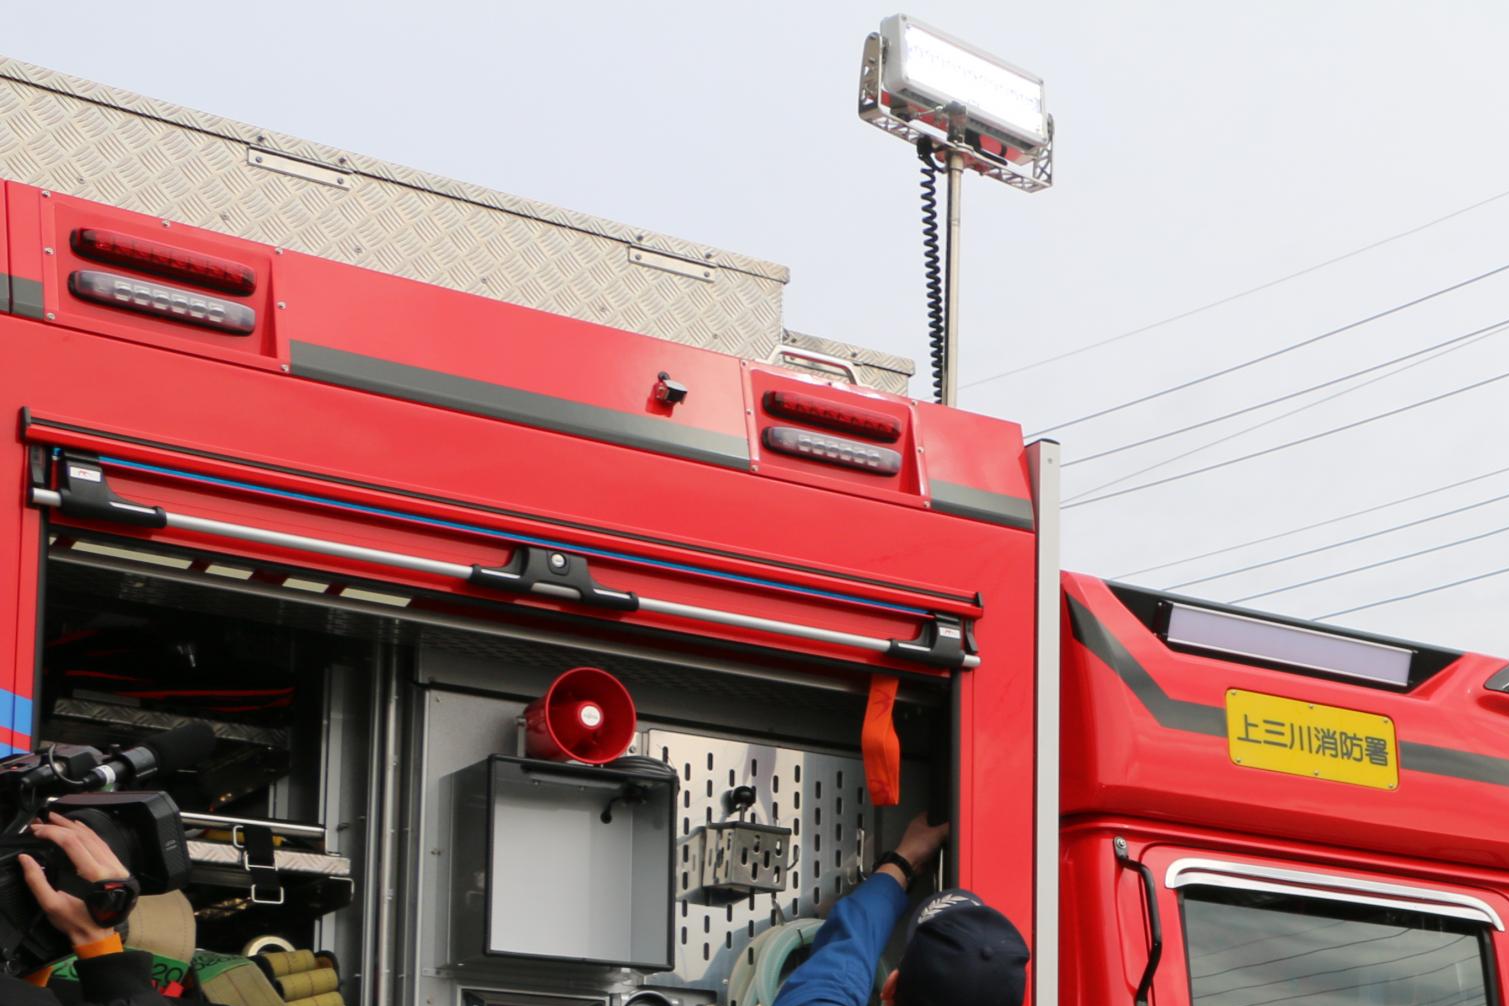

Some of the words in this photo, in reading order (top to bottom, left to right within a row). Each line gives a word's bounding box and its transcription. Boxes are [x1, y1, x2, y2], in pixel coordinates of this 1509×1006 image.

[1237, 714, 1389, 767] 上三川消防署
